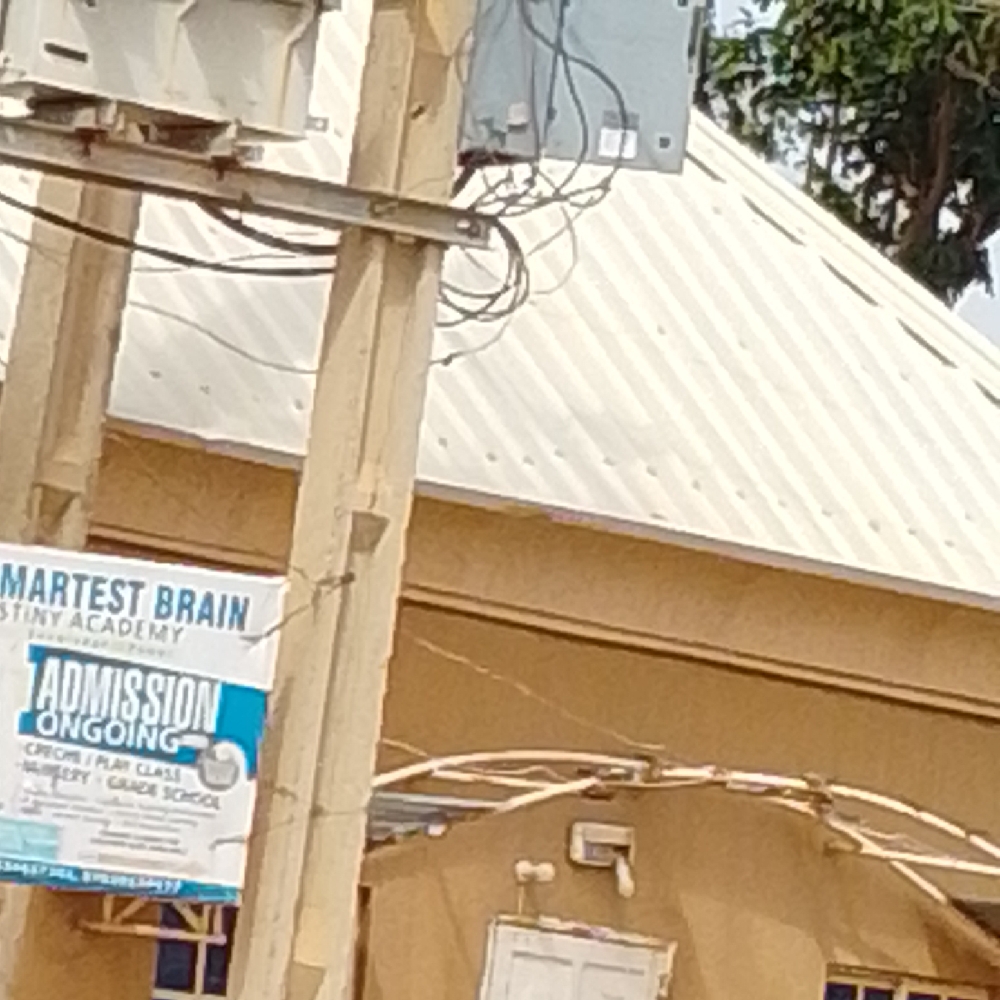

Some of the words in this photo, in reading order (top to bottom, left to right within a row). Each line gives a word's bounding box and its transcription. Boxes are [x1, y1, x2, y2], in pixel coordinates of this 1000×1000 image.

[69, 611, 184, 644] ACADEMY
[153, 584, 250, 631] BRAIN
[36, 657, 222, 734] ADMISSION
[36, 711, 179, 753] ONGOING
